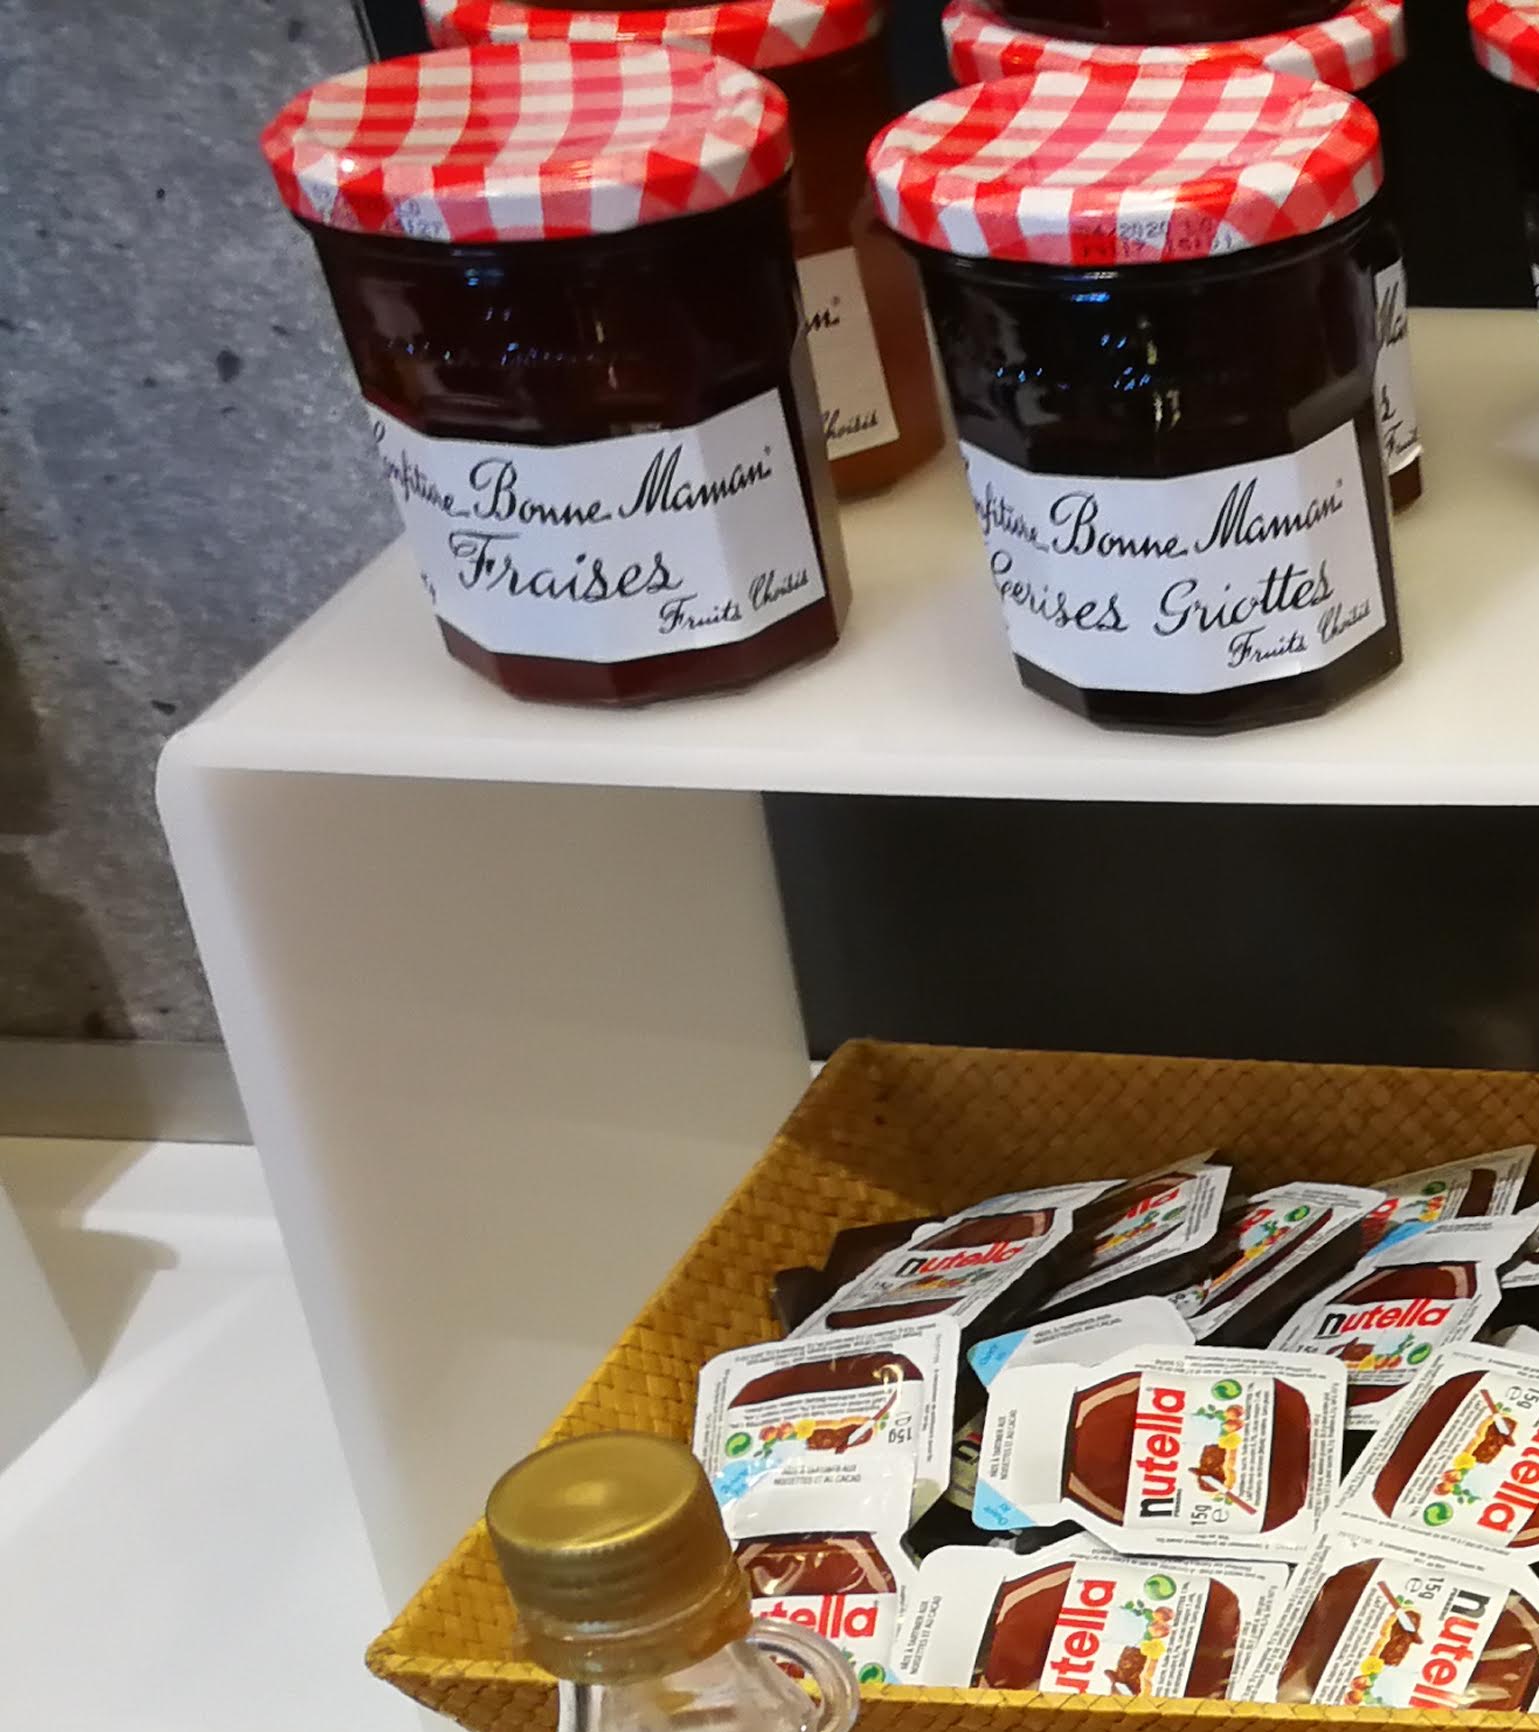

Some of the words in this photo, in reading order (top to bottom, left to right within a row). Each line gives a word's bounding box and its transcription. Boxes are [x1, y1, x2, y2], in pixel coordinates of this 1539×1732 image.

[470, 457, 612, 521] Bonne
[618, 446, 772, 520] Maman
[1050, 490, 1188, 558] Bonne
[1194, 477, 1343, 553] Maman
[449, 531, 684, 602] Fraises
[1153, 561, 1335, 636] Griottes
[659, 595, 743, 635] Fruits
[1227, 630, 1307, 668] Fruits
[896, 1241, 1027, 1275] nutella
[1316, 1297, 1451, 1338] nutella
[1136, 1386, 1189, 1519] nutella
[1049, 1579, 1117, 1695] utella
[1410, 1588, 1493, 1709] nutell
